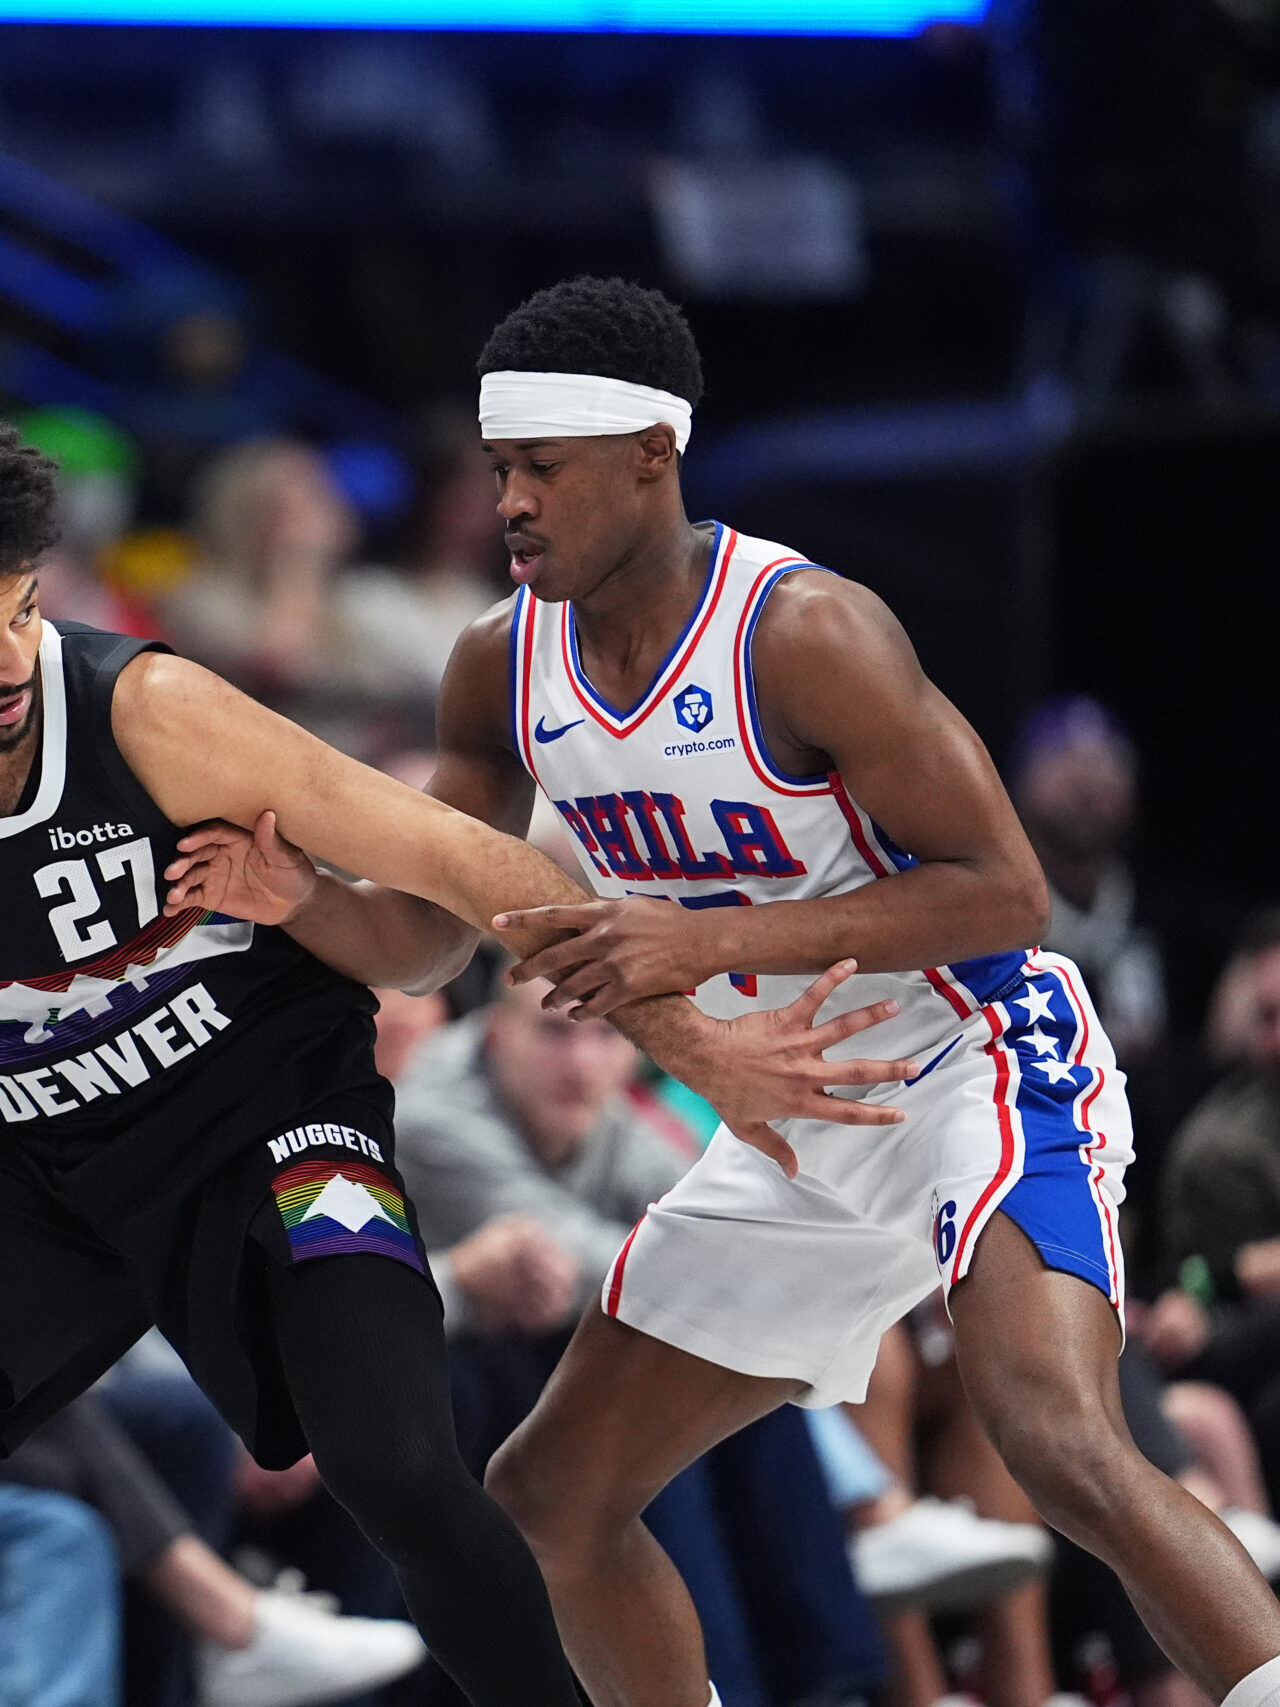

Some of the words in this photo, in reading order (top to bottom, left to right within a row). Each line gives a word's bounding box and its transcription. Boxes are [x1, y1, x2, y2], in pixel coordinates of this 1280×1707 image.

[664, 738, 736, 756] crypto.com
[48, 822, 134, 851] ibotta
[551, 789, 808, 881] PHILA
[33, 836, 159, 963] 27
[266, 1123, 385, 1164] NUGGETS
